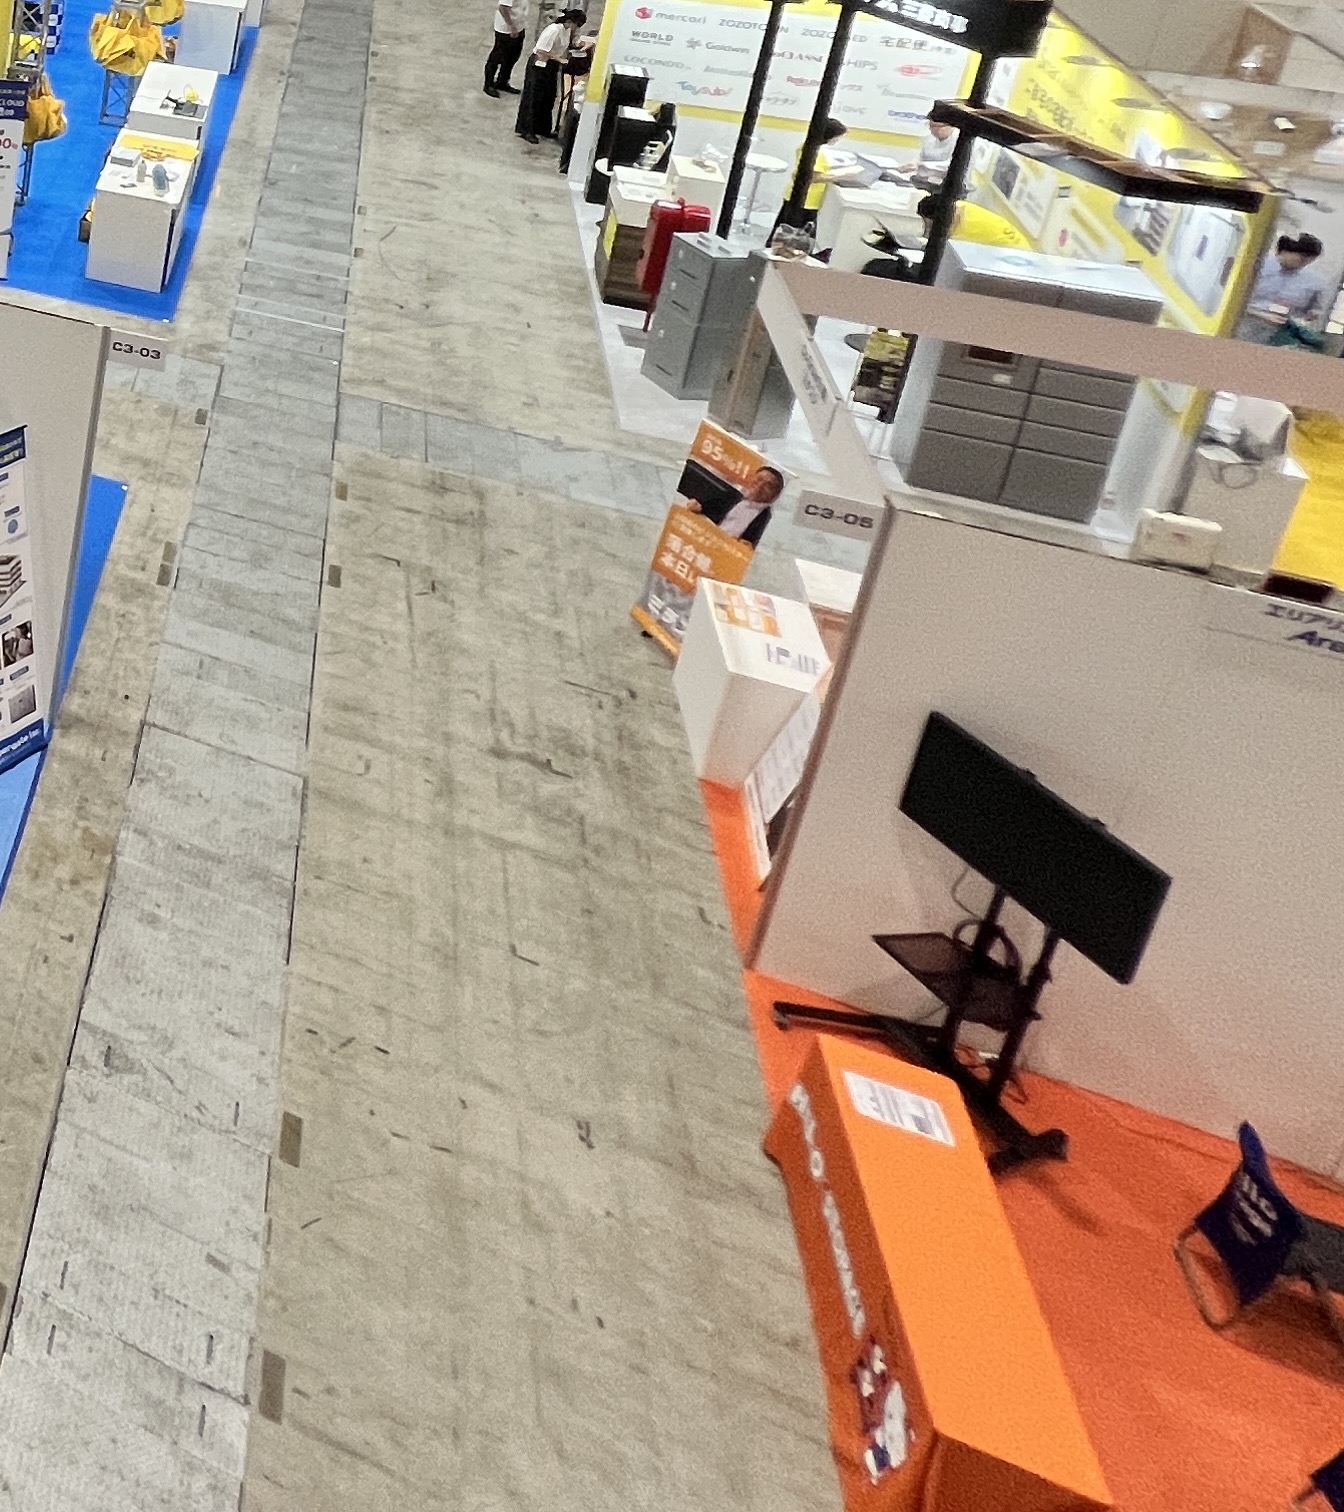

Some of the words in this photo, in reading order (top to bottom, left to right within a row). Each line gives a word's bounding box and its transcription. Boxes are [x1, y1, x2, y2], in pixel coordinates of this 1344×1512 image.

[655, 10, 707, 25] mercari
[718, 18, 790, 34] ZOZOTON
[631, 30, 674, 42] WORLD
[112, 341, 162, 360] C3-03
